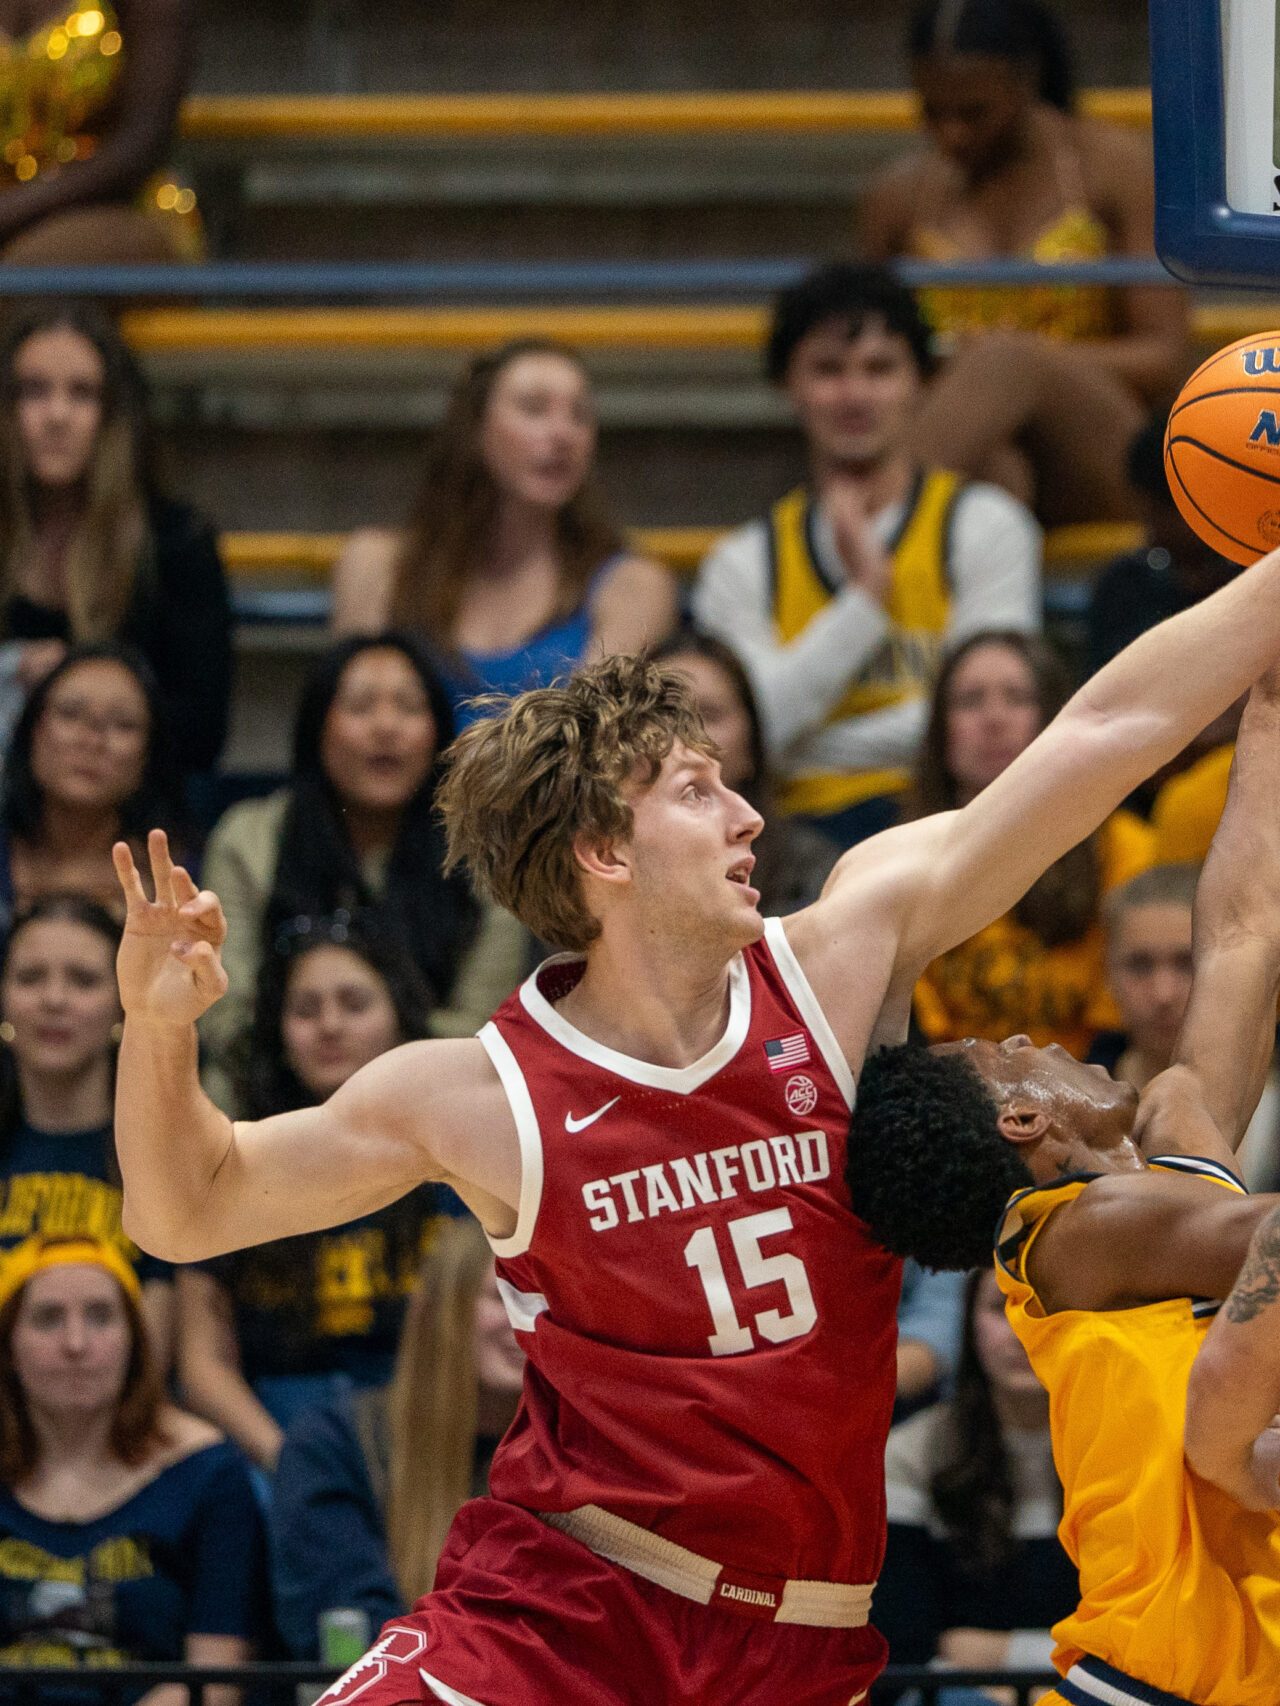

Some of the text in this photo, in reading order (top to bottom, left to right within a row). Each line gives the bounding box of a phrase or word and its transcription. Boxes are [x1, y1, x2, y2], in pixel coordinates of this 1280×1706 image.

[581, 1129, 830, 1232] STANFORD
[683, 1205, 818, 1356] 15
[720, 1582, 776, 1608] CARDINAL
